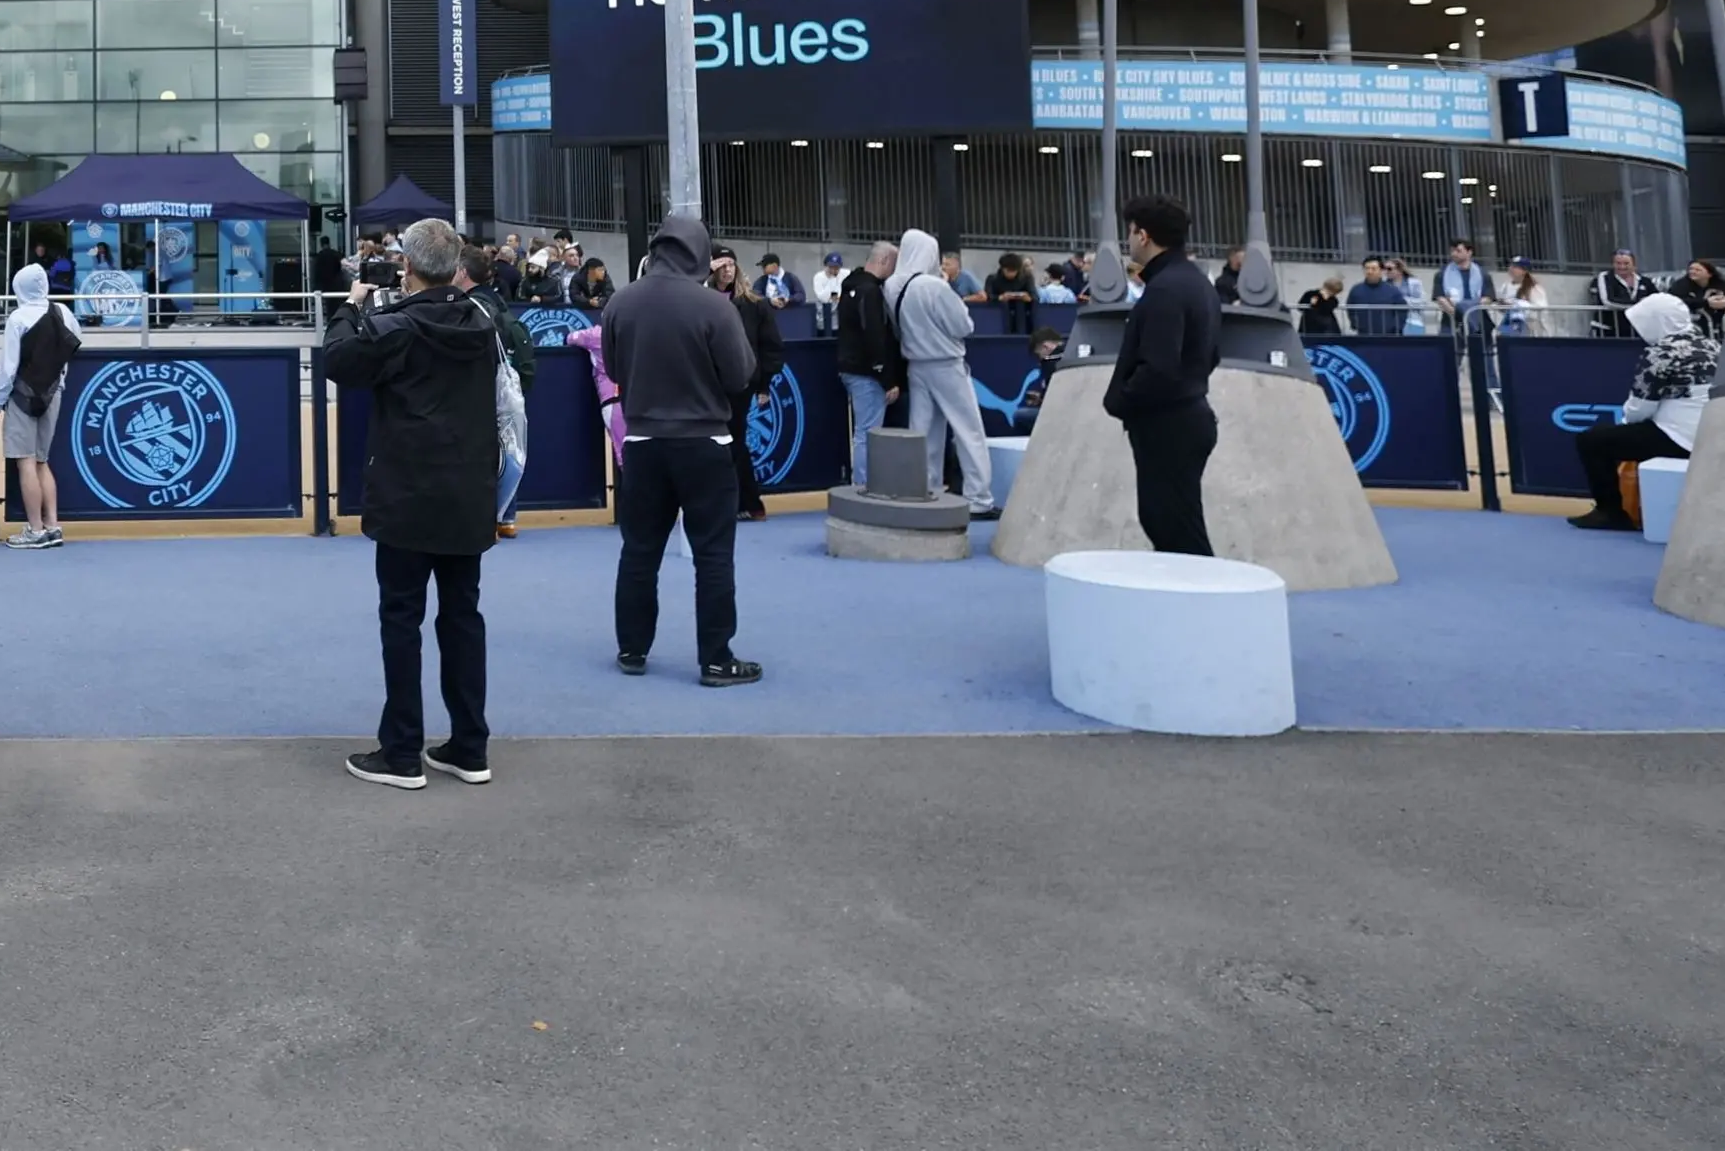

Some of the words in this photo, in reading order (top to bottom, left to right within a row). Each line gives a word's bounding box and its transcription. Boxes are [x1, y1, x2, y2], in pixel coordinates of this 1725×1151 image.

[692, 12, 869, 69] Blues
[452, 29, 463, 95] RECEPTION
[1125, 70, 1151, 84] CITY
[1177, 70, 1213, 85] BLUES
[1059, 86, 1096, 100] SOUTH
[1179, 89, 1245, 103] SOUTHPORT
[1122, 105, 1191, 119] VANCOUVER
[1518, 82, 1539, 132] T
[120, 201, 188, 217] MANCHESTER
[190, 203, 212, 217] CITY
[527, 310, 584, 330] NCHESTER
[86, 363, 207, 428] MANCHESTER
[206, 411, 221, 423] 94
[88, 445, 101, 457] 18
[149, 480, 193, 506] CITY
